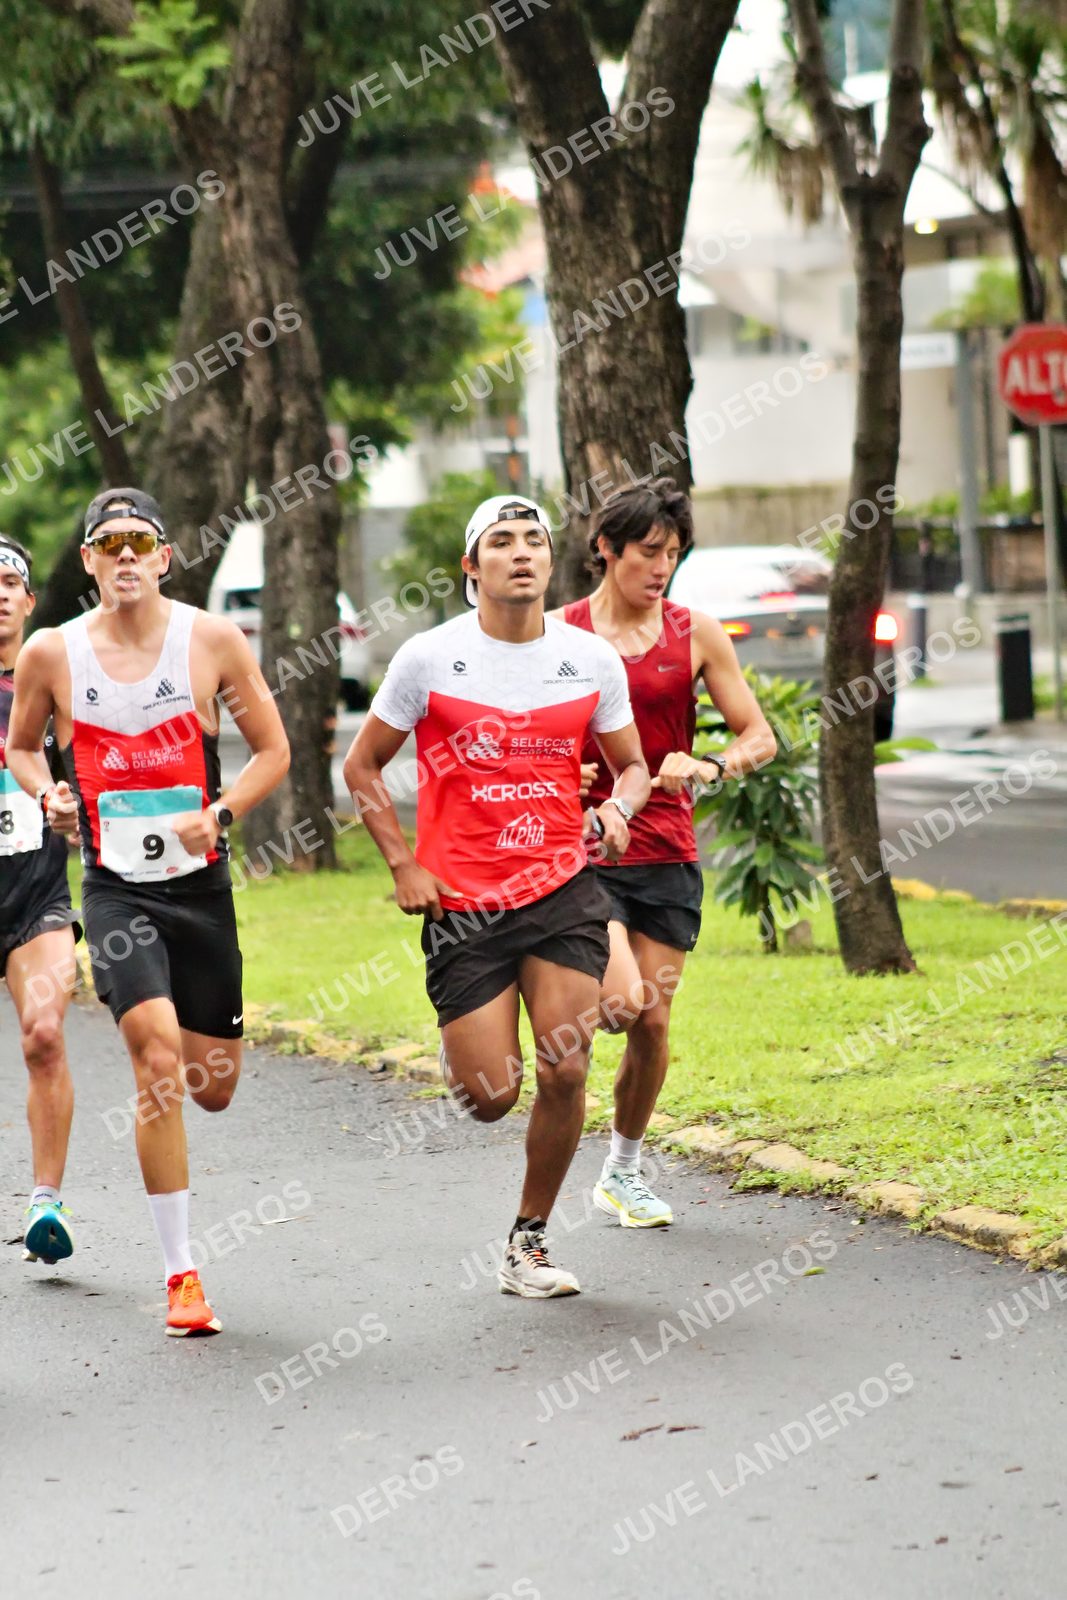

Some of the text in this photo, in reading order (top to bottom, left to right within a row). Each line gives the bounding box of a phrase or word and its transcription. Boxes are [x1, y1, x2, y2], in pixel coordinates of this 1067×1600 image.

[132, 751, 184, 769] DEMAPRO
[498, 824, 546, 847] ALPHA
[143, 834, 165, 861] 9
